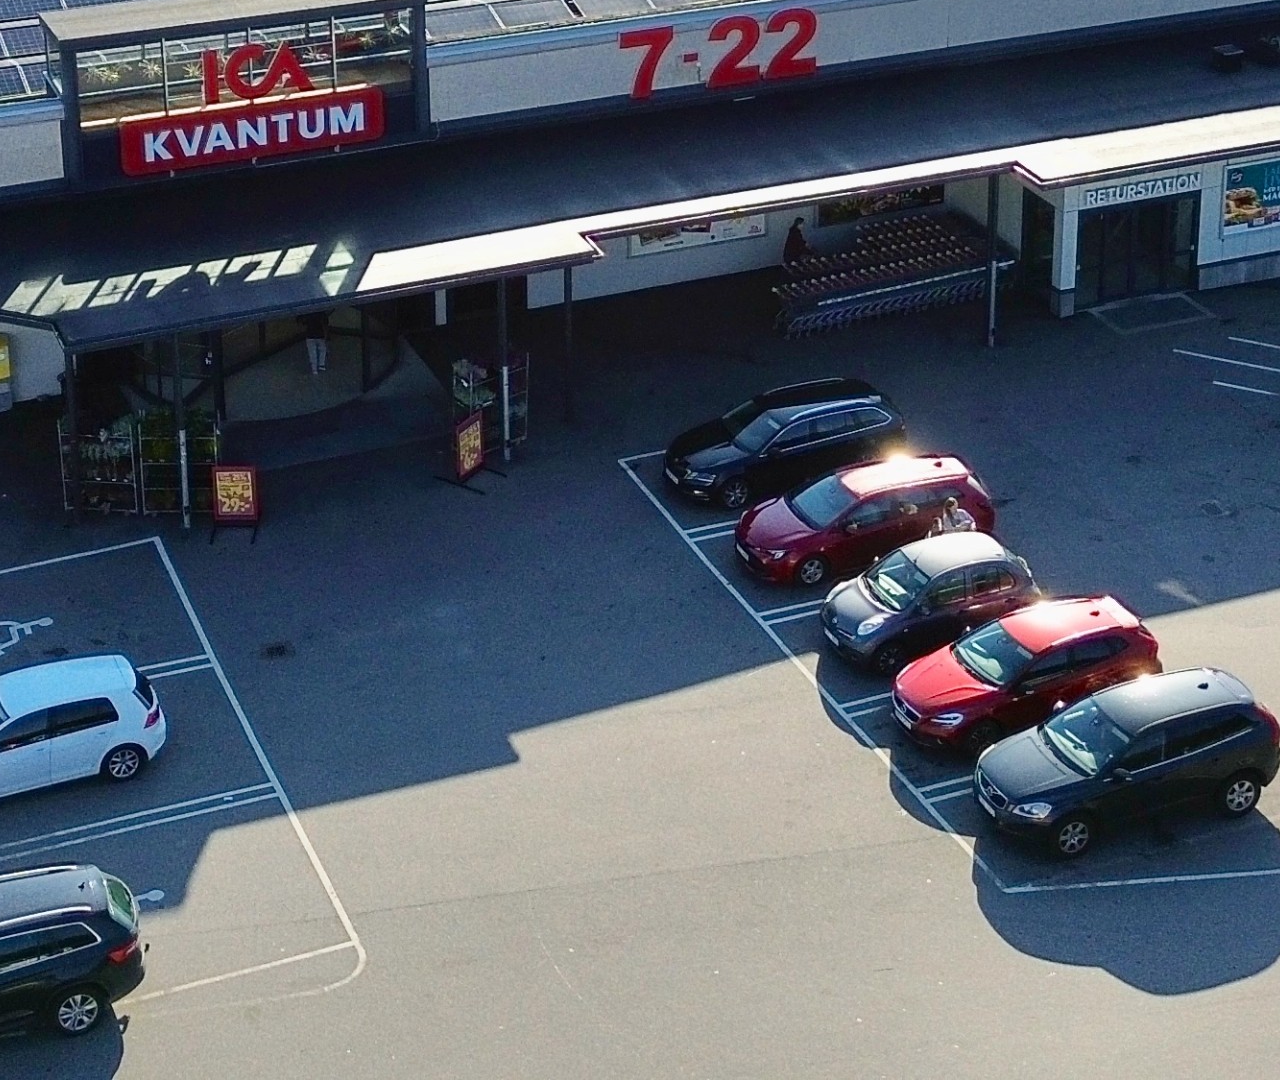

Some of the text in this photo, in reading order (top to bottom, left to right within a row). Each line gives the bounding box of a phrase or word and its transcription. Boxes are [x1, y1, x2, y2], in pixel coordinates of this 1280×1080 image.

[201, 41, 315, 105] ICA
[618, 7, 818, 100] 7-22
[143, 102, 367, 164] KVANTUM
[1086, 173, 1201, 206] RETURSTATION
